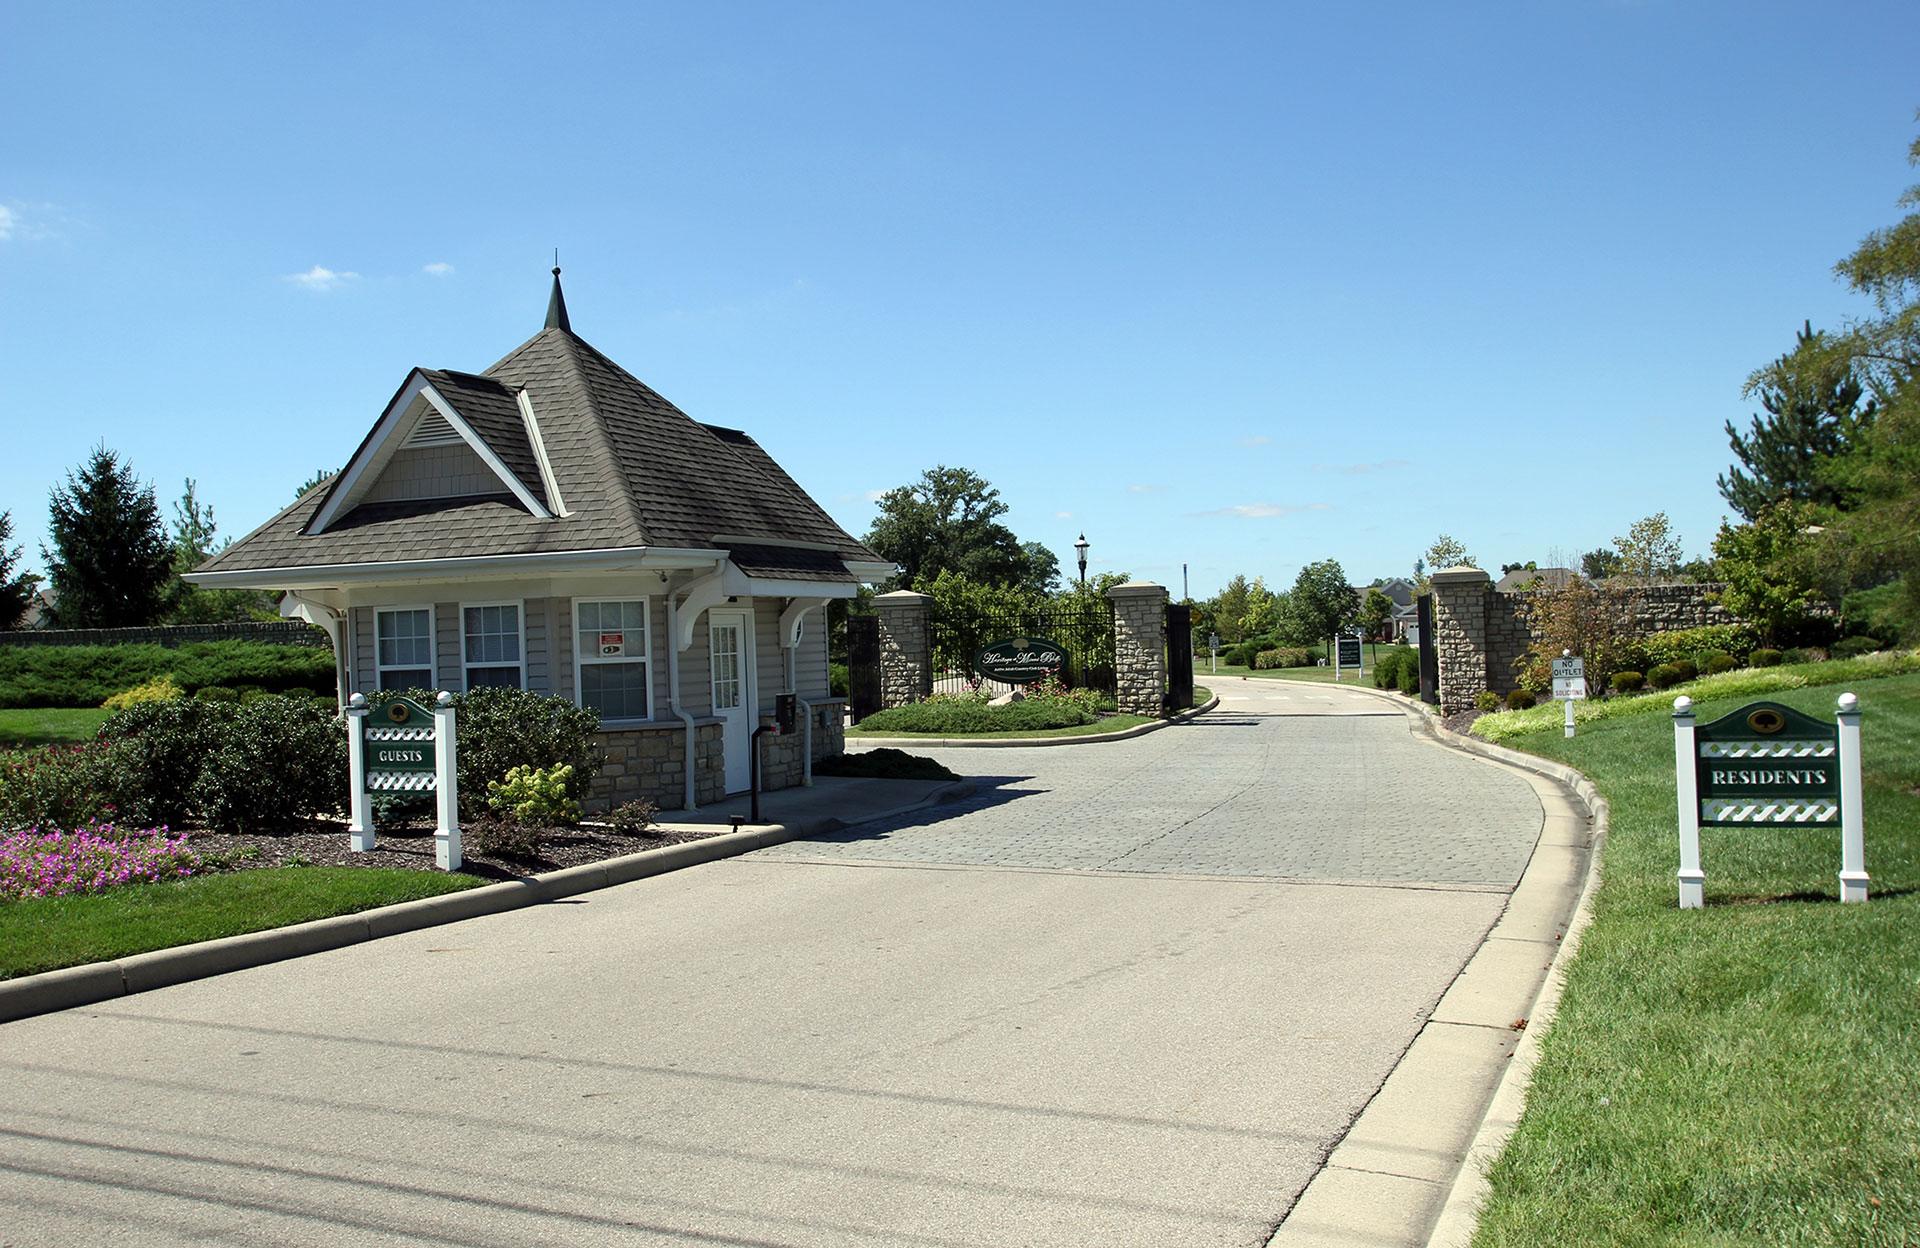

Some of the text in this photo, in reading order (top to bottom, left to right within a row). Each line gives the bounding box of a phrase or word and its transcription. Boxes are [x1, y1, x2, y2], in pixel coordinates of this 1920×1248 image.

[1554, 668, 1581, 676] OUTLET
[379, 750, 422, 761] GUESTS
[1712, 770, 1827, 784] RESIDENTS
